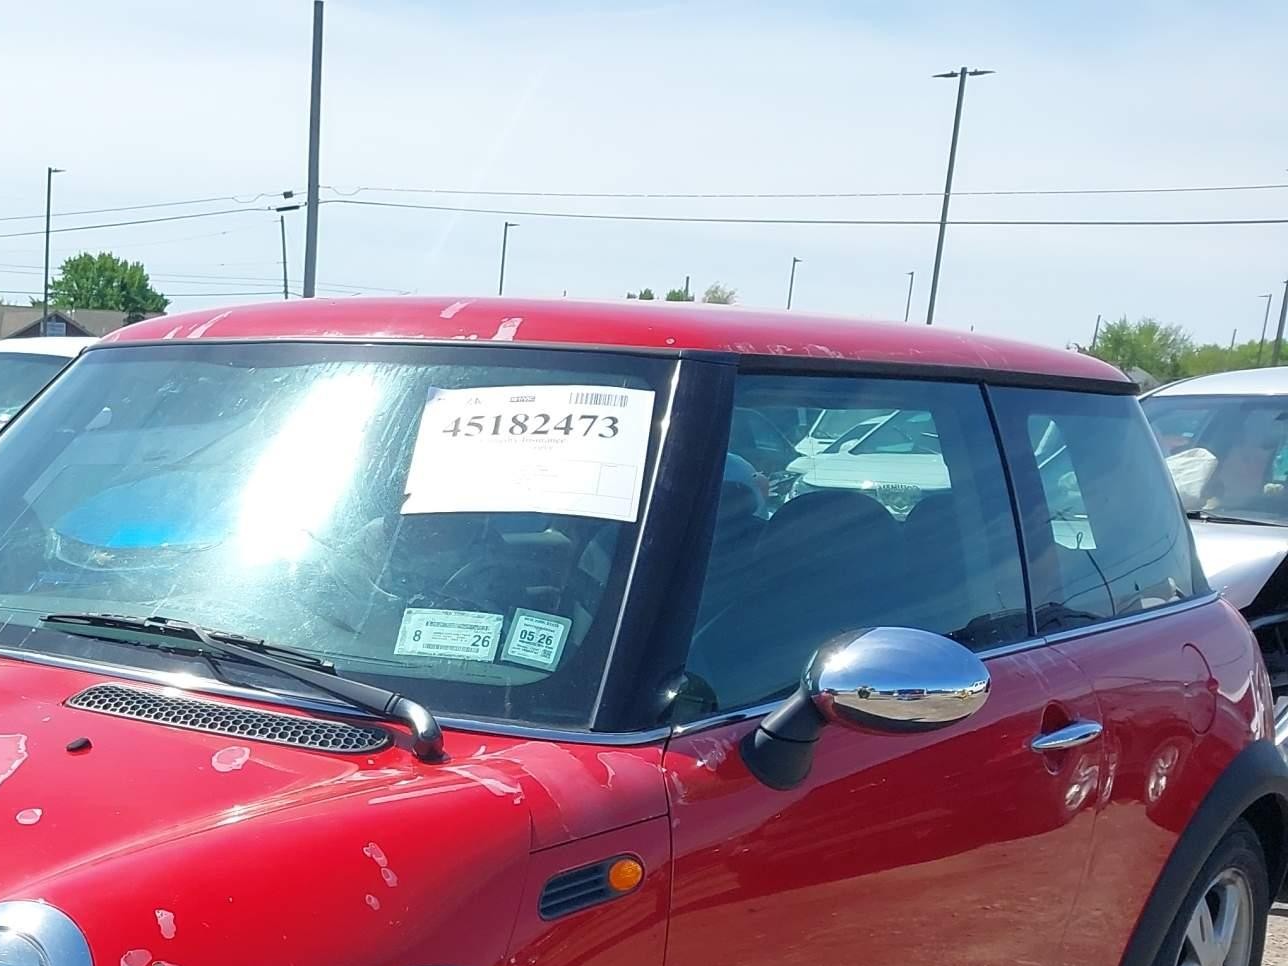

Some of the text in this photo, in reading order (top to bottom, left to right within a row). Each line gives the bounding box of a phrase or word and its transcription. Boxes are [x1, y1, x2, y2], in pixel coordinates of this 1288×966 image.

[442, 413, 619, 438] 45182473
[413, 630, 422, 642] 8
[471, 634, 491, 648] 26
